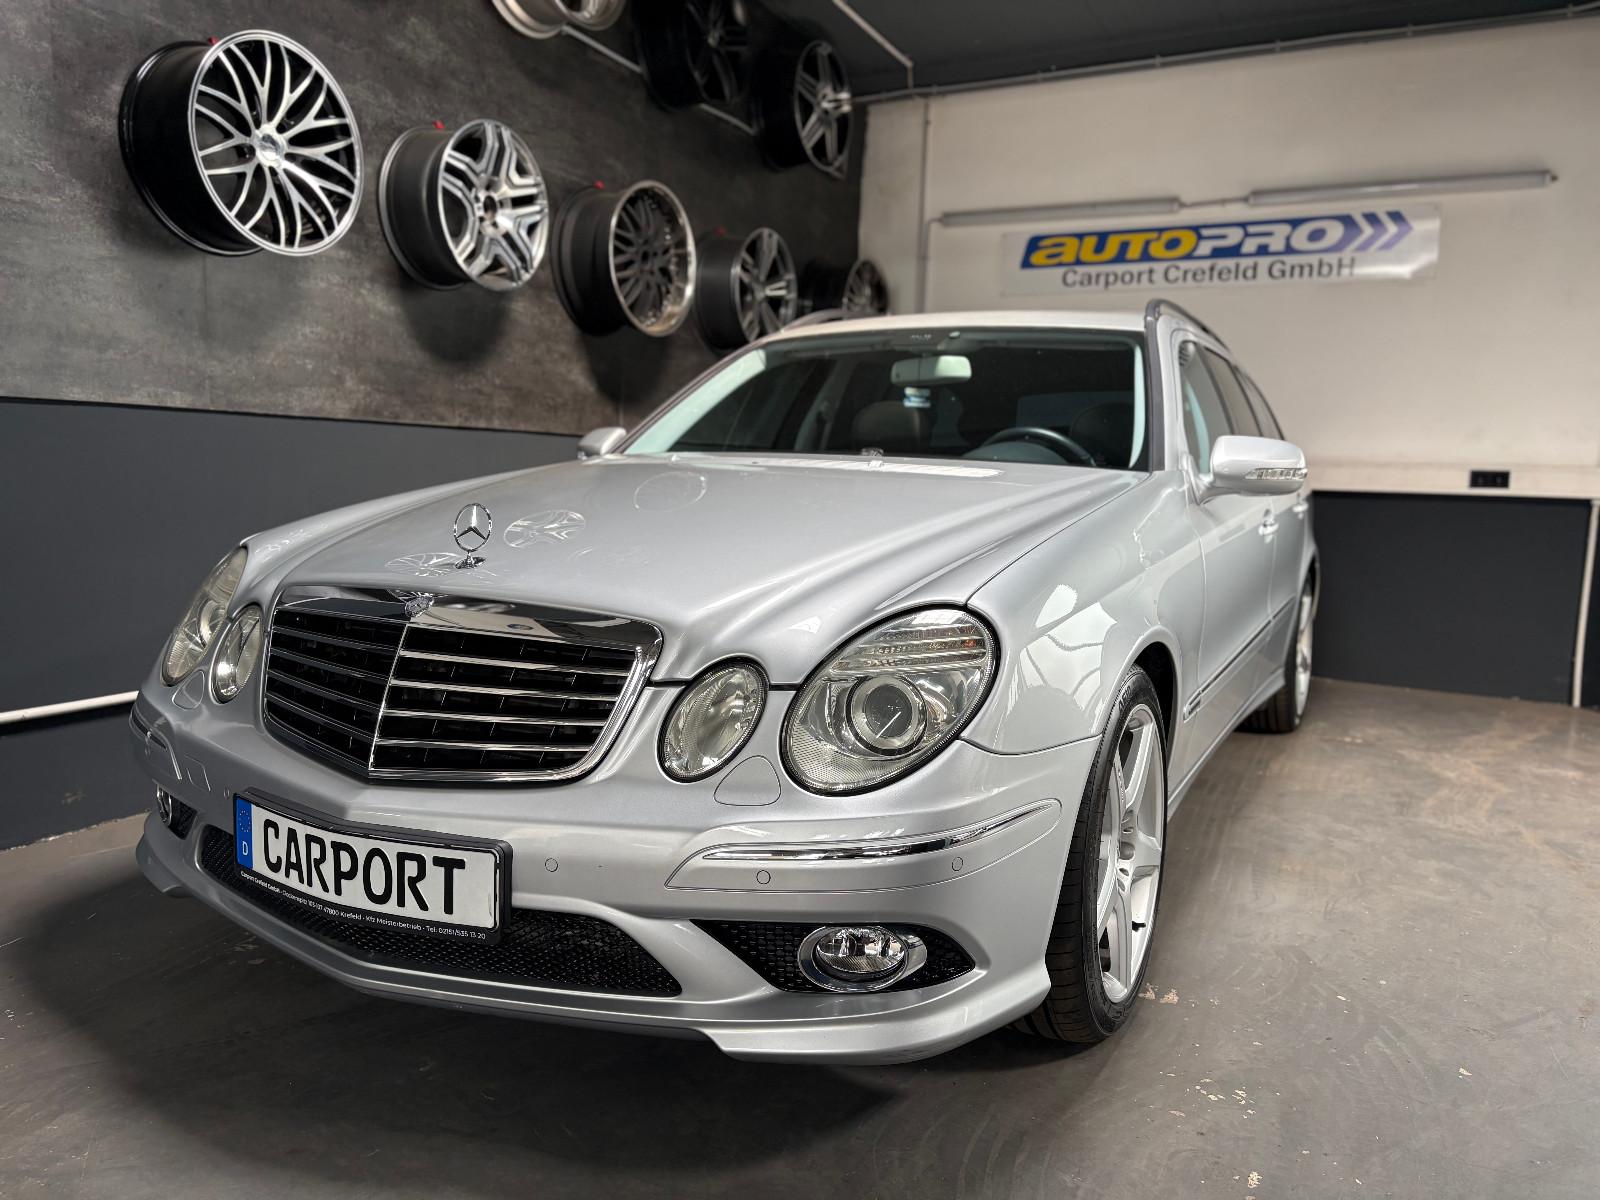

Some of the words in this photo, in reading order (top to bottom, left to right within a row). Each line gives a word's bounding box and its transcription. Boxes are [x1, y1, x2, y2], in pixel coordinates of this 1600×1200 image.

[1061, 267, 1156, 289] Carport
[1163, 259, 1258, 284] Crefeld
[1267, 257, 1357, 281] GmbH
[242, 841, 249, 856] D
[263, 818, 466, 915] CARPORT
[340, 910, 362, 920] Krefeld
[376, 918, 422, 931] Meisterbetrieb
[477, 932, 486, 940] 20
